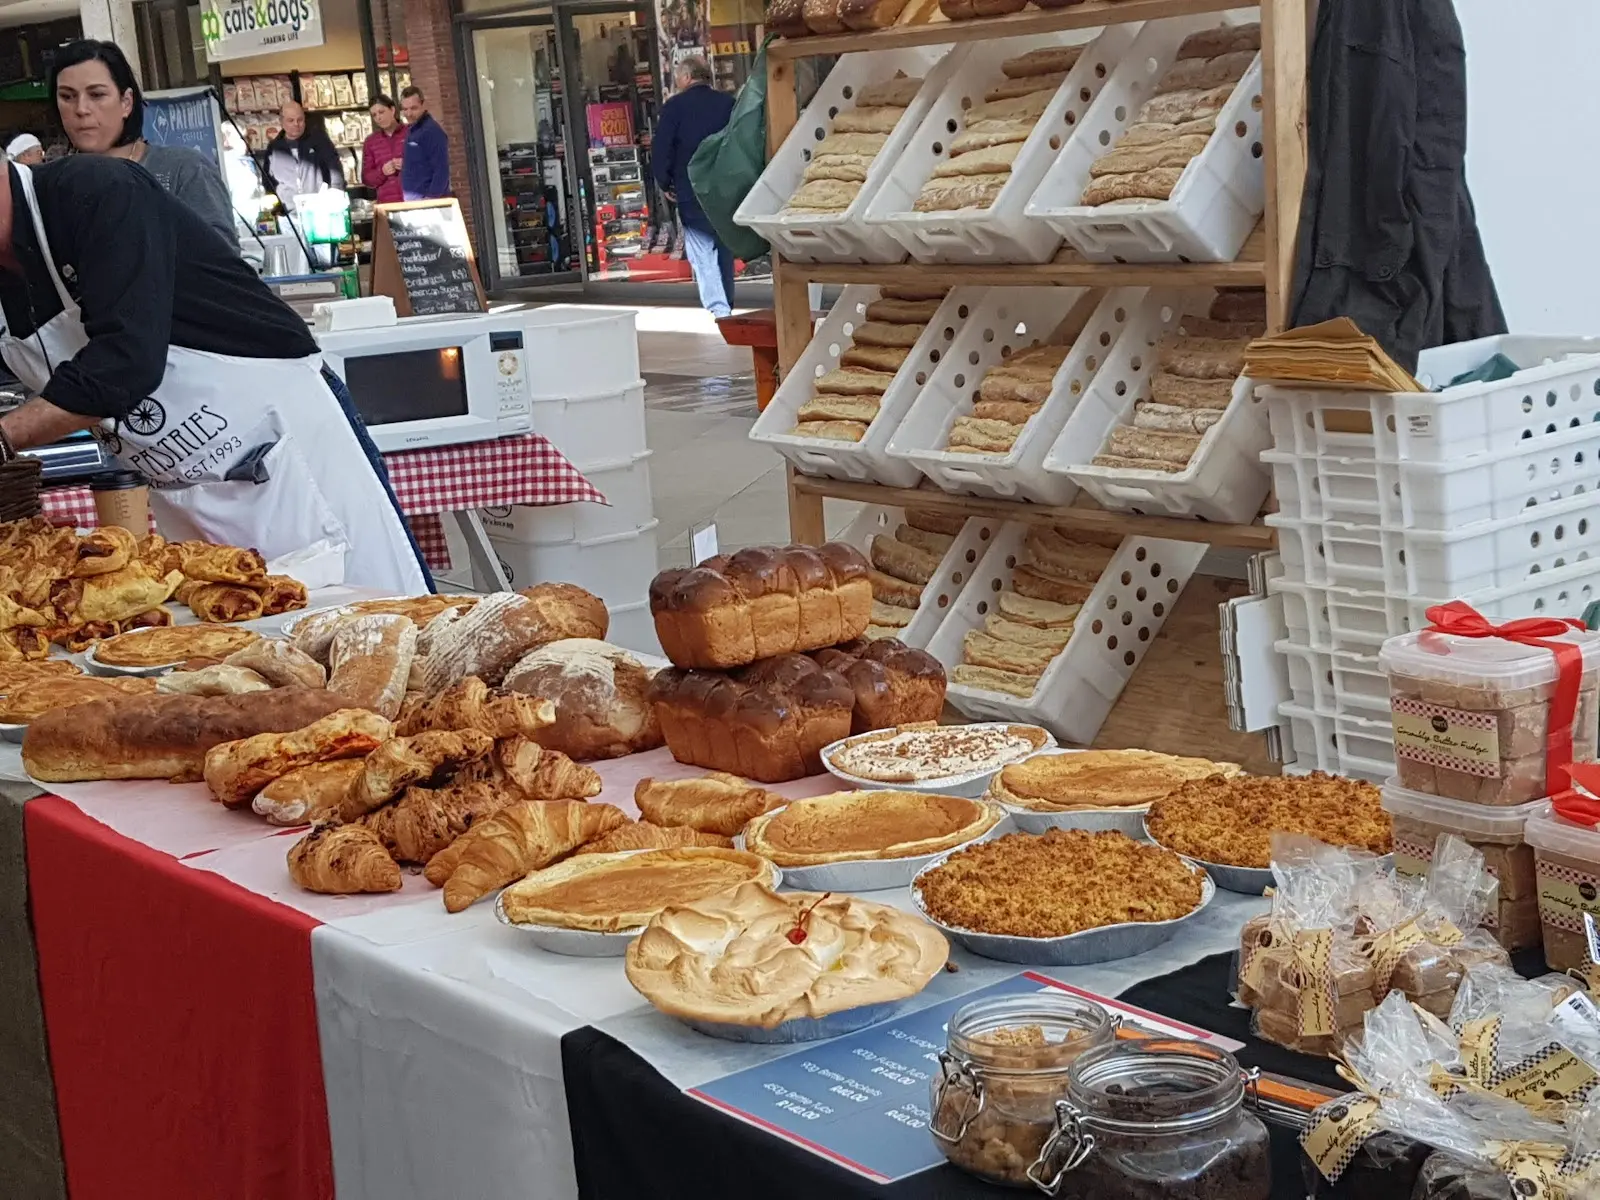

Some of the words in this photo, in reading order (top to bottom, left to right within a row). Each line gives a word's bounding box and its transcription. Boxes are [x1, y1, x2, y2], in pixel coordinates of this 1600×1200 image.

[168, 99, 210, 132] PATRIOT
[601, 119, 627, 136] R200
[129, 404, 228, 477] PASTRIES
[1397, 726, 1430, 743] Crumbly
[1433, 735, 1458, 747] Butter
[1461, 741, 1488, 756] Fudge
[1542, 891, 1577, 910] Crumbly
[871, 1066, 916, 1085] R140.00
[829, 1085, 869, 1102] R40.00
[842, 1079, 882, 1096] Pockets
[775, 1100, 820, 1119] R140.00
[884, 1109, 926, 1128] R40.00
[1316, 1135, 1338, 1164] Crumbly
[1337, 1117, 1363, 1136] Butter
